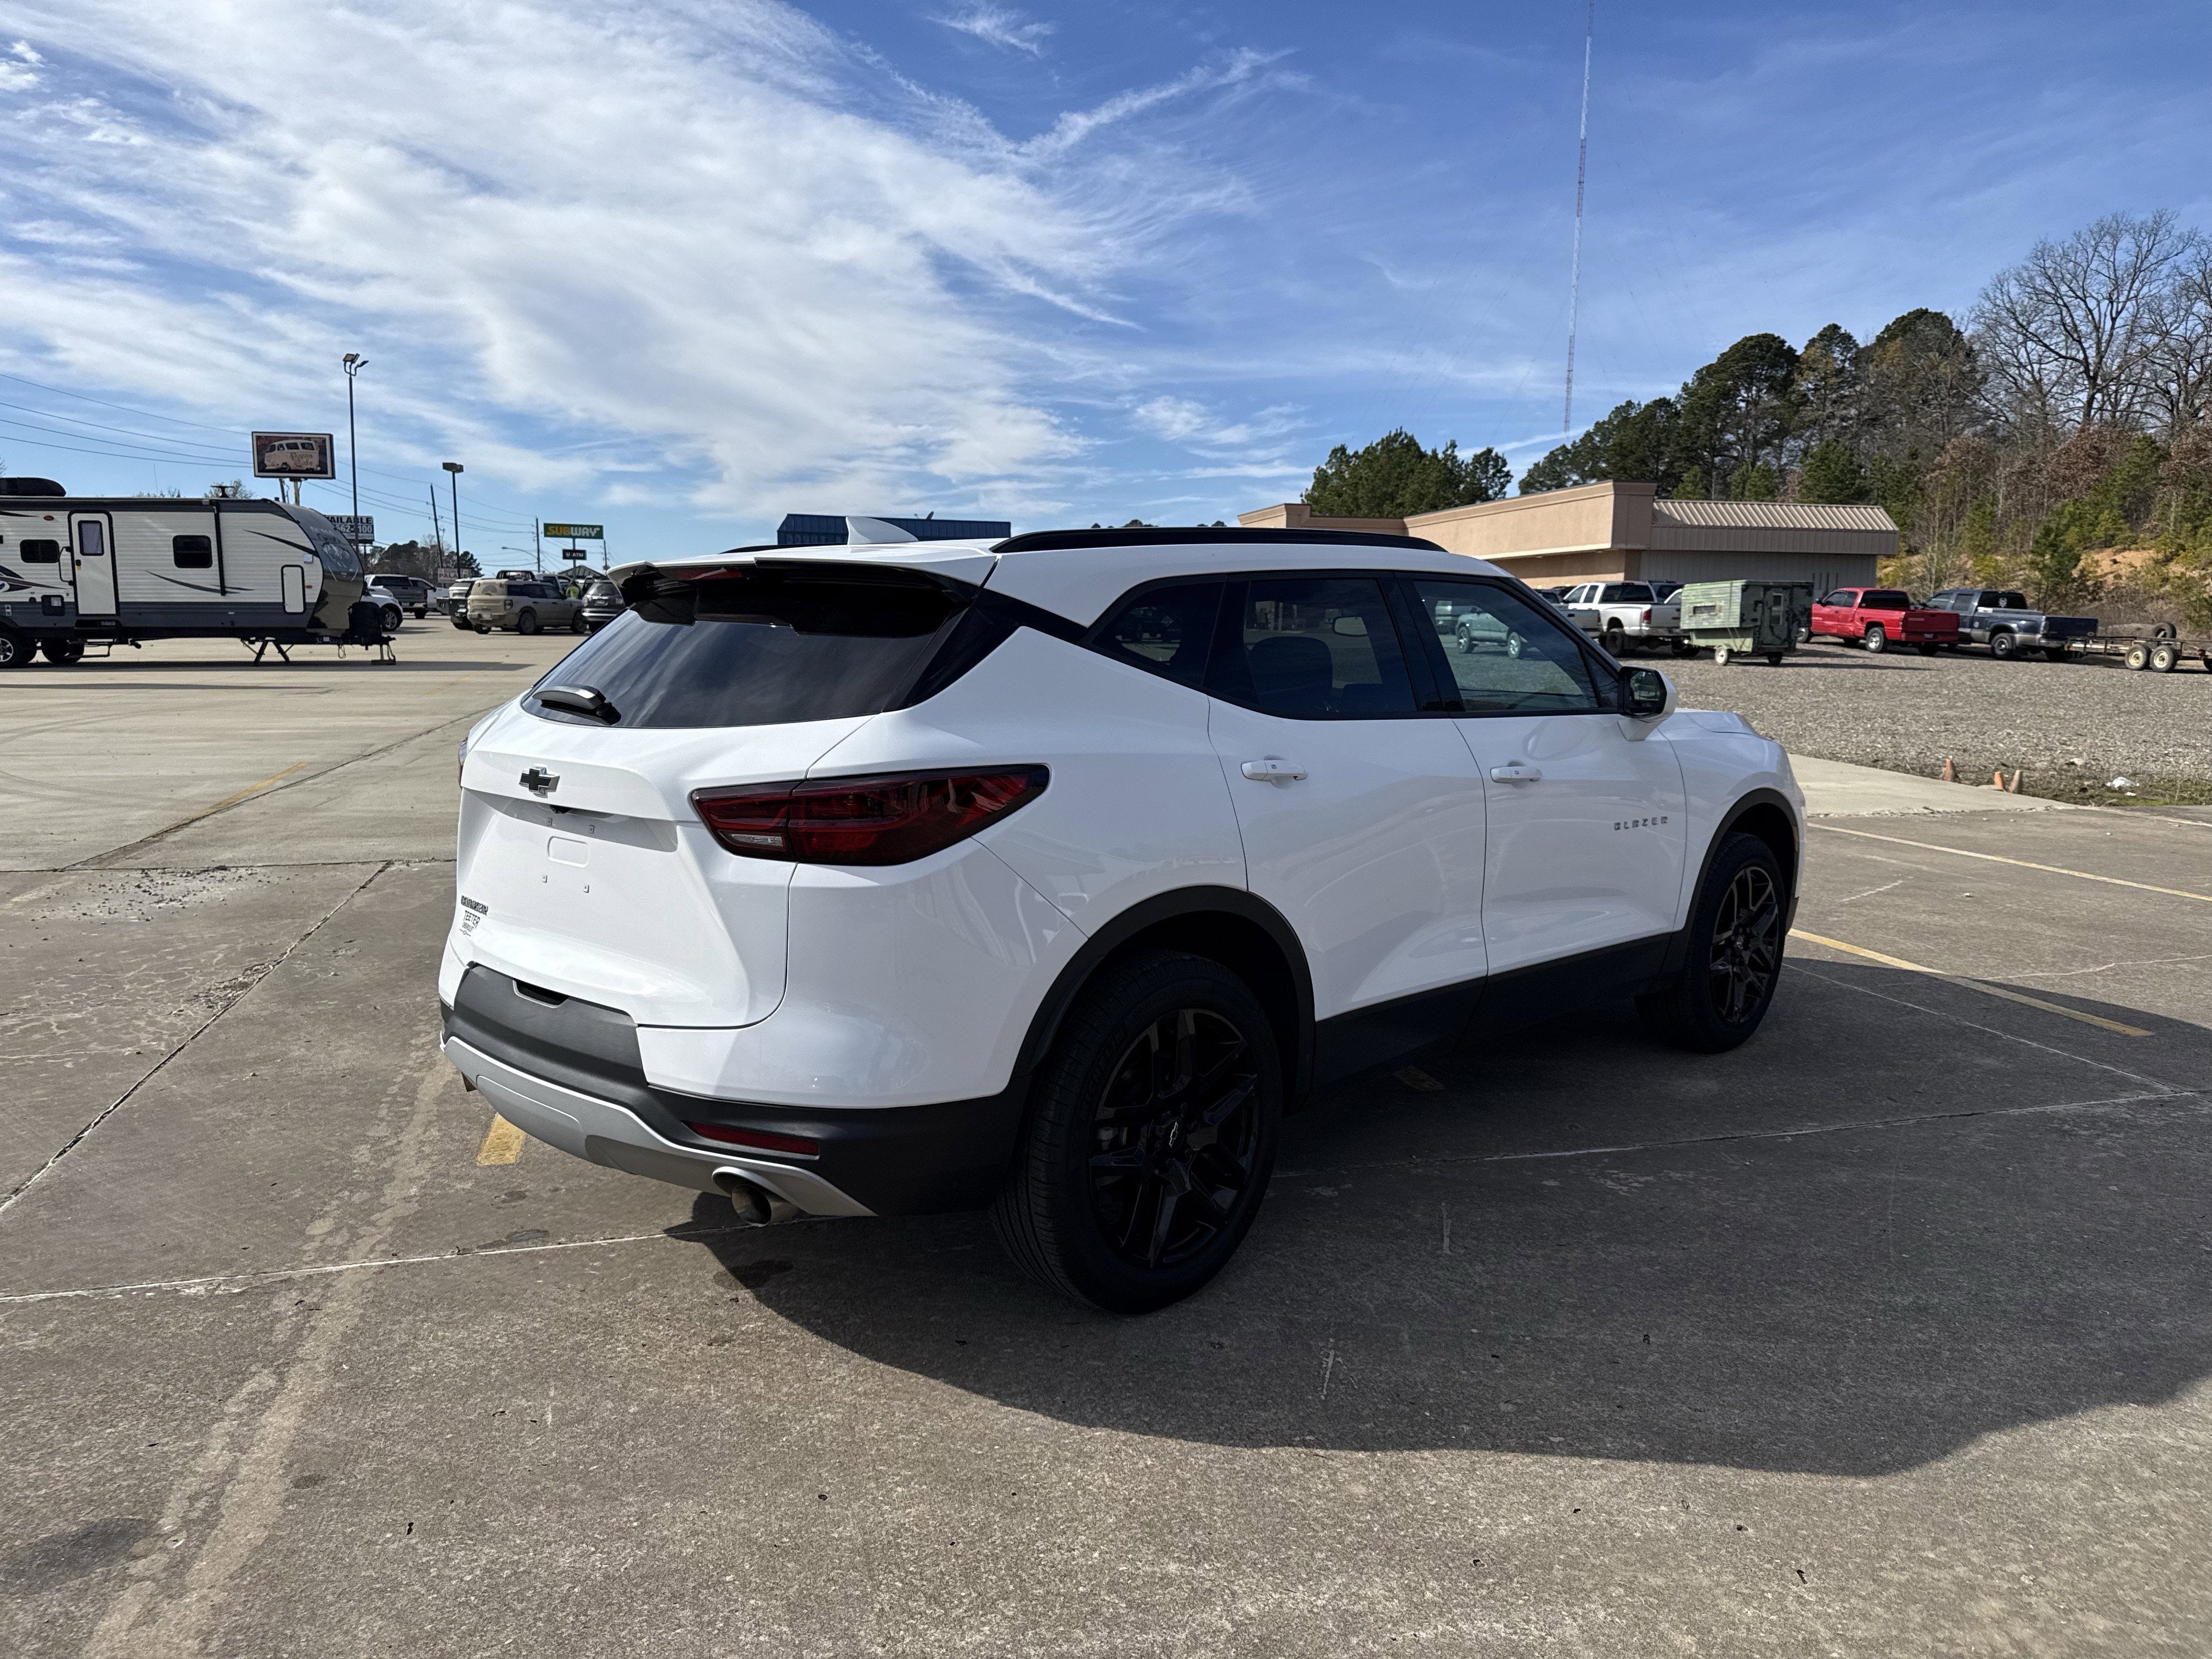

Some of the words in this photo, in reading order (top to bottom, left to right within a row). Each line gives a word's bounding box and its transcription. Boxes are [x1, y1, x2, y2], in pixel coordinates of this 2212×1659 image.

[546, 526, 601, 537] SUBWAY
[1614, 816, 1668, 831] BLAZER
[464, 910, 481, 929] TEETER
